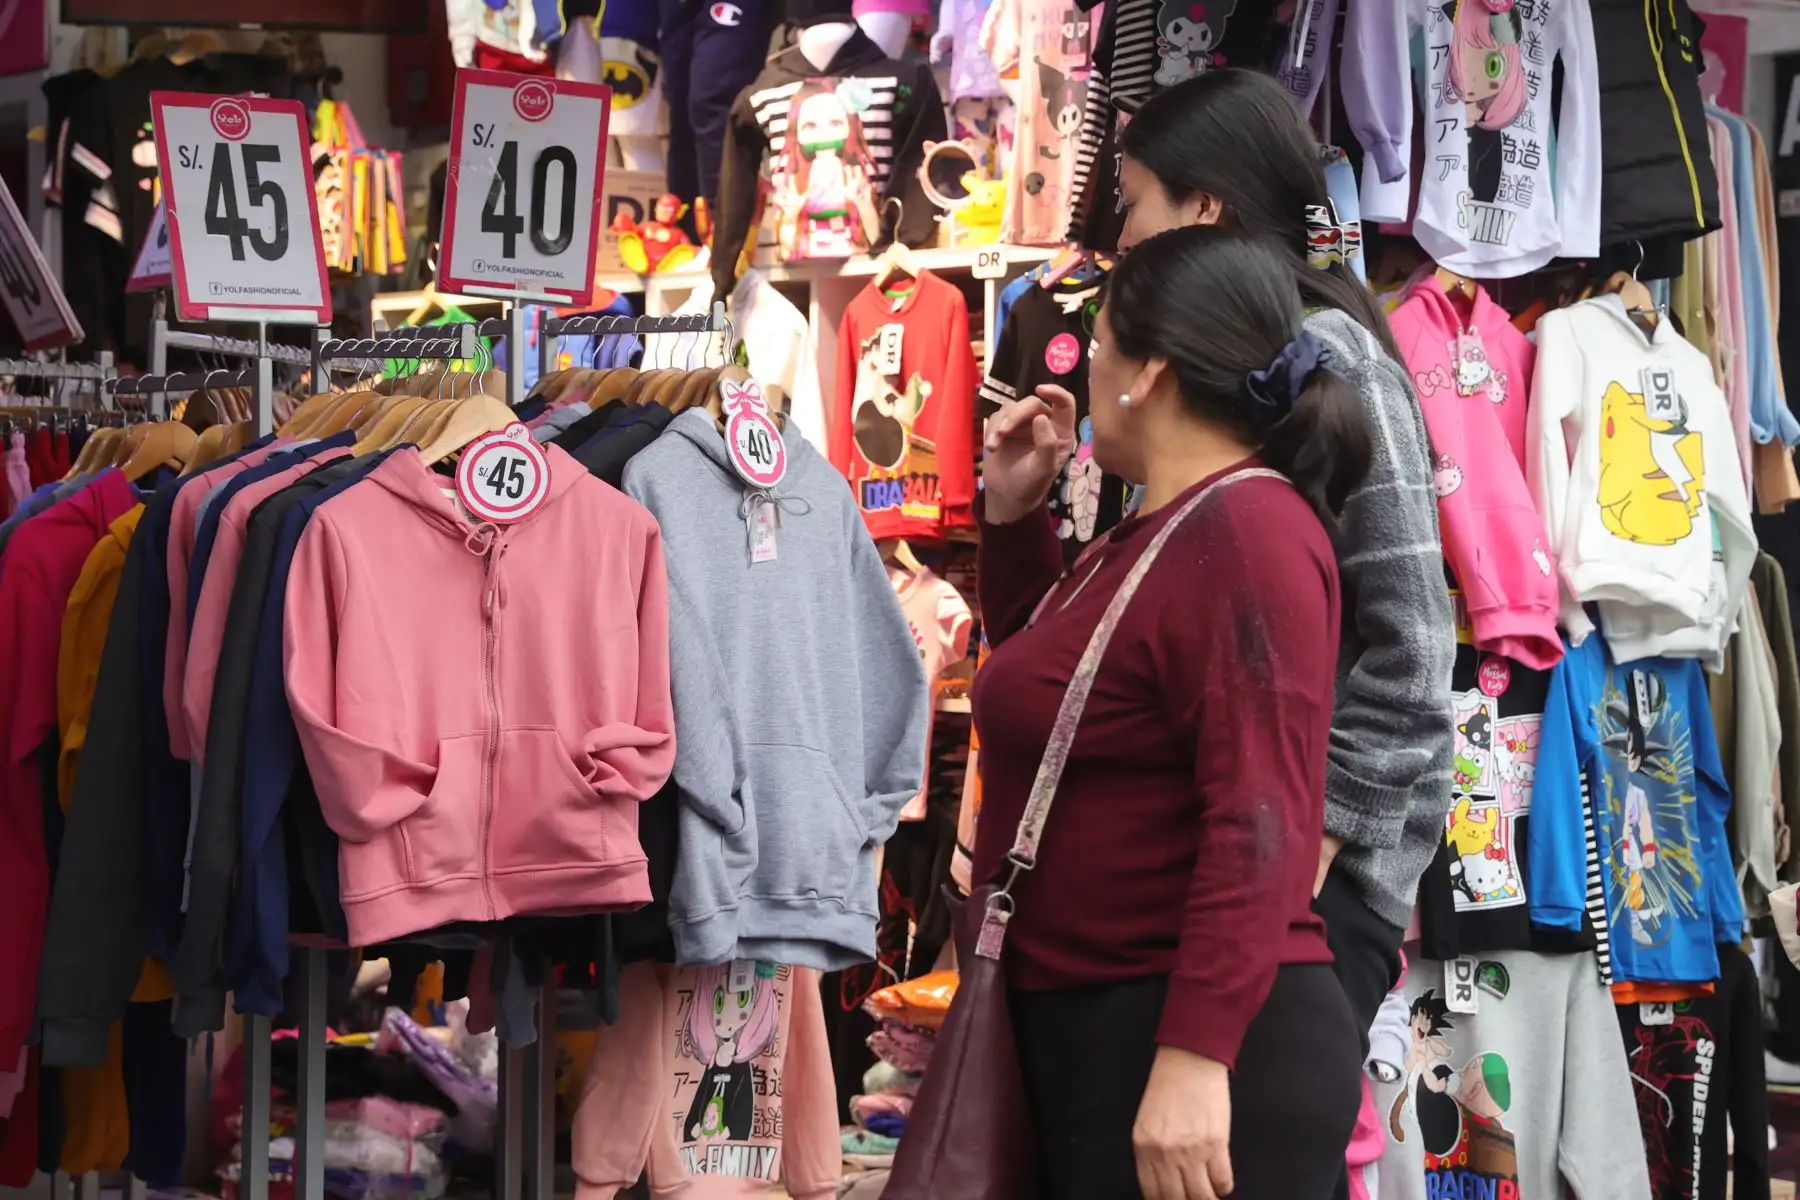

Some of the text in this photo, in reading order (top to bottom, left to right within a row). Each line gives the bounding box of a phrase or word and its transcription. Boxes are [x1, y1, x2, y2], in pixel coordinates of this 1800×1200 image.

[204, 142, 290, 262] 45
[481, 140, 578, 259] 40
[486, 263, 565, 280] YOLFASHIONOFICIAL
[978, 251, 1001, 268] DR
[222, 285, 302, 297] YOLFASHIONOFICIAL
[1651, 372, 1672, 412] DR
[748, 428, 773, 466] 40
[486, 456, 527, 499] 45
[1455, 961, 1472, 1002] DR
